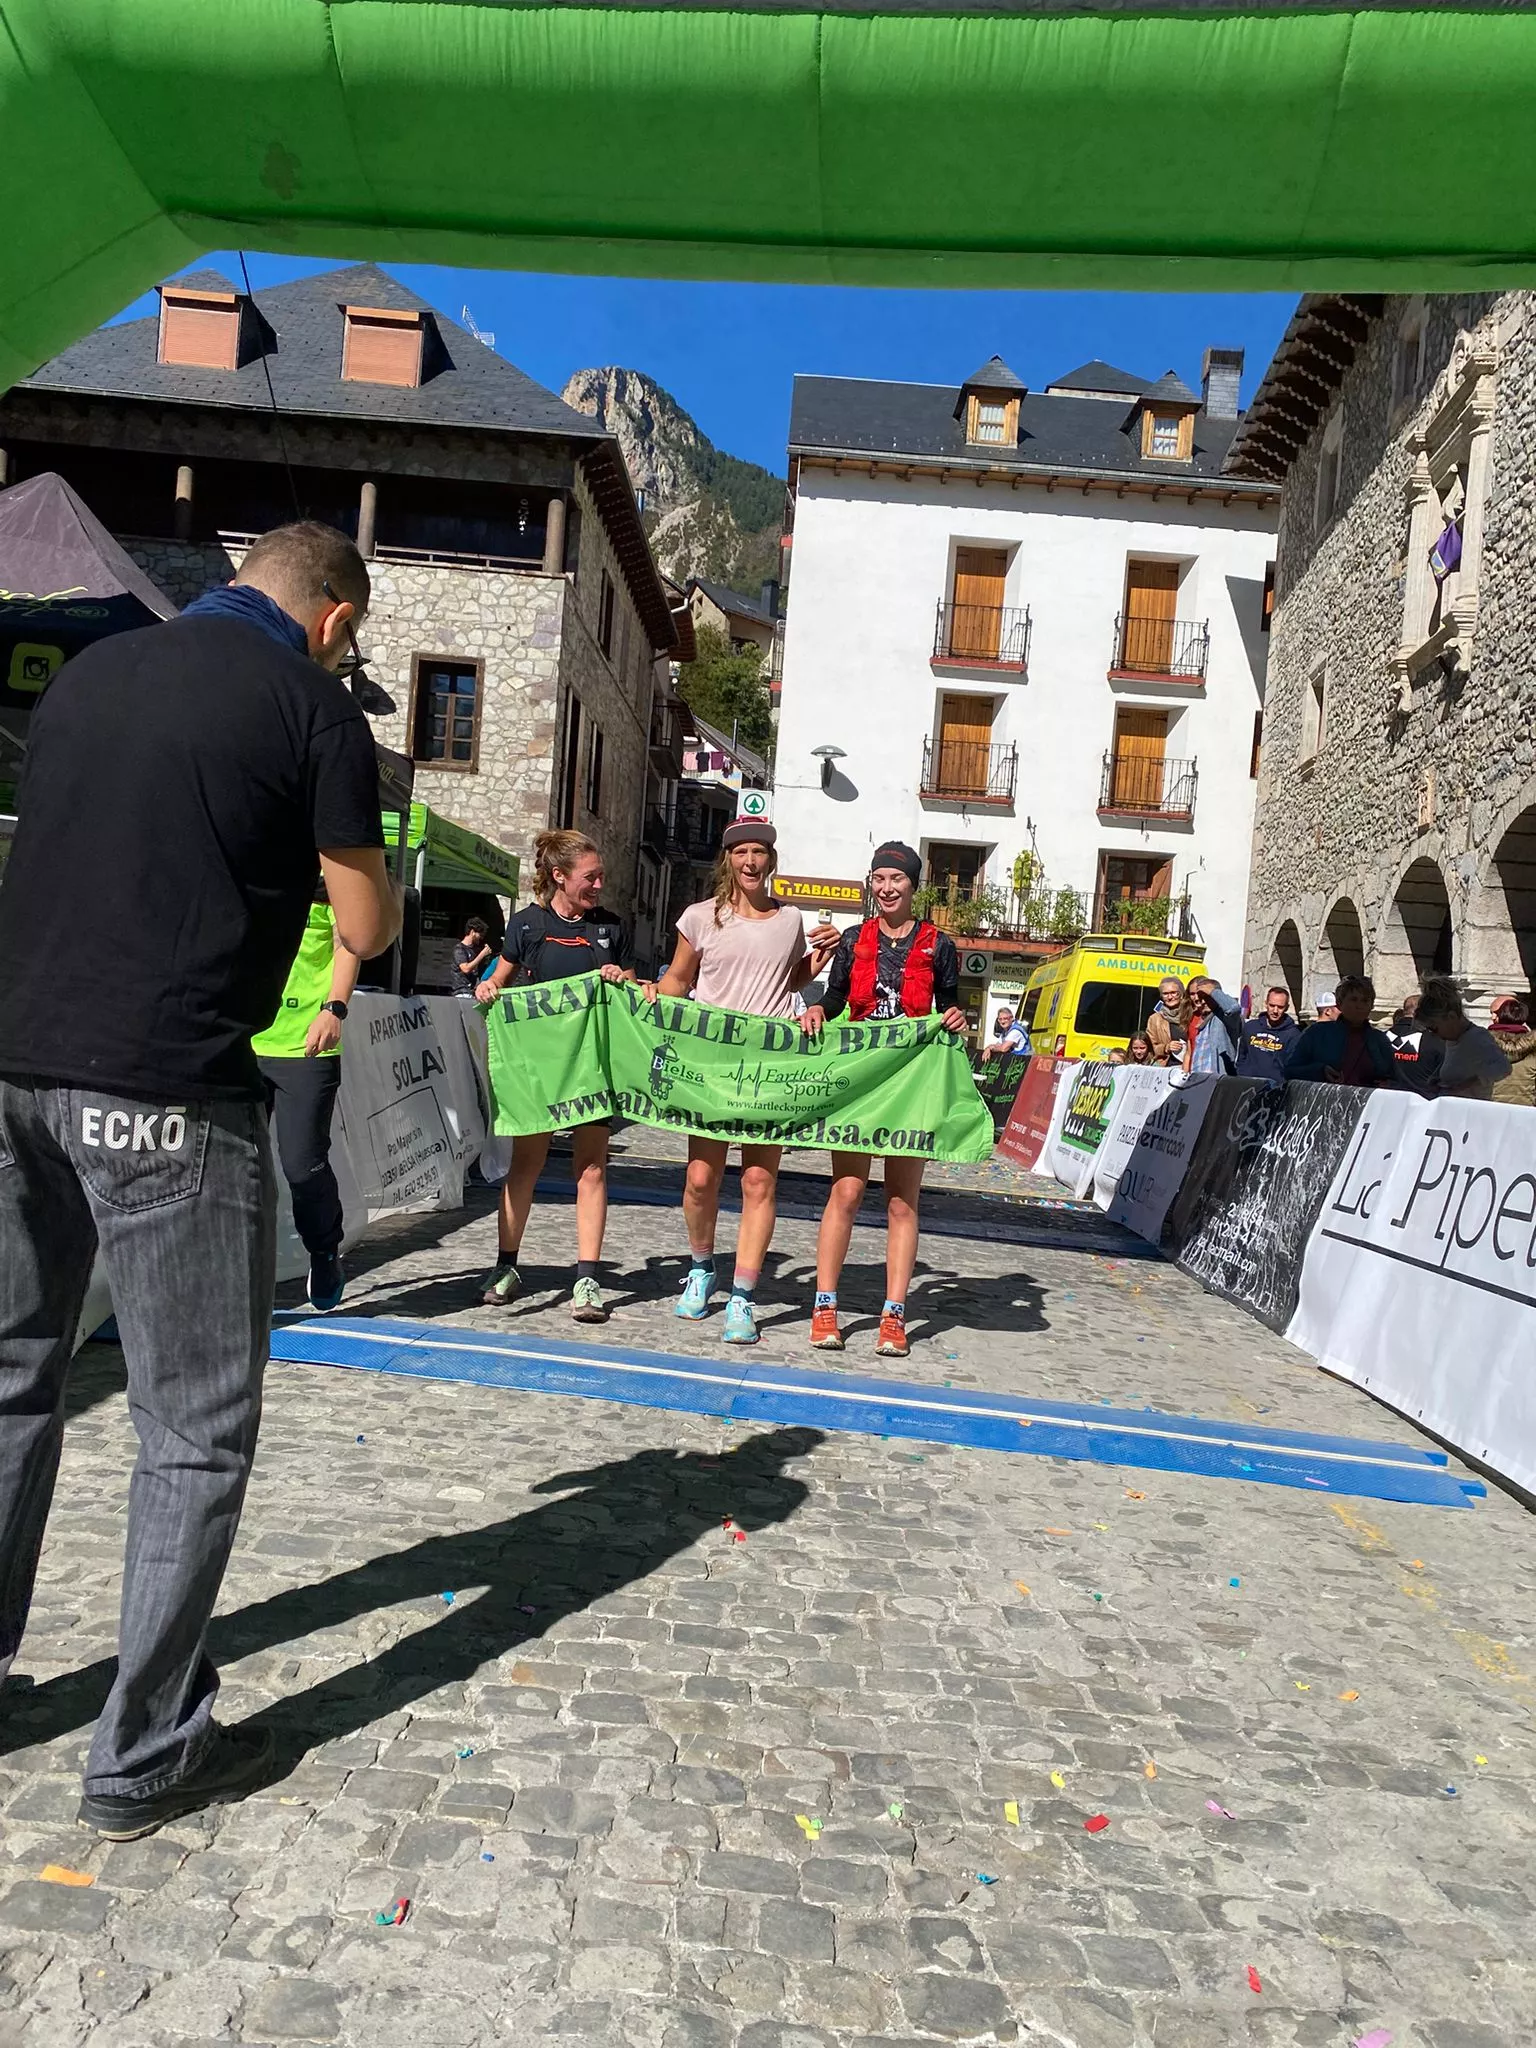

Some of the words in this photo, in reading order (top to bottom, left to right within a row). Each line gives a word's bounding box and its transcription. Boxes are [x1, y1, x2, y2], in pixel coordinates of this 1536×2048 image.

[794, 882, 861, 899] TABACOS
[1096, 957, 1191, 977] AMBULANCIA
[501, 976, 612, 1024] TRAIL
[625, 984, 749, 1047] VALLE
[761, 1020, 824, 1057] DE
[836, 1019, 965, 1055] BIELS
[652, 1053, 705, 1083] Bielsa
[783, 1080, 833, 1102] Sport
